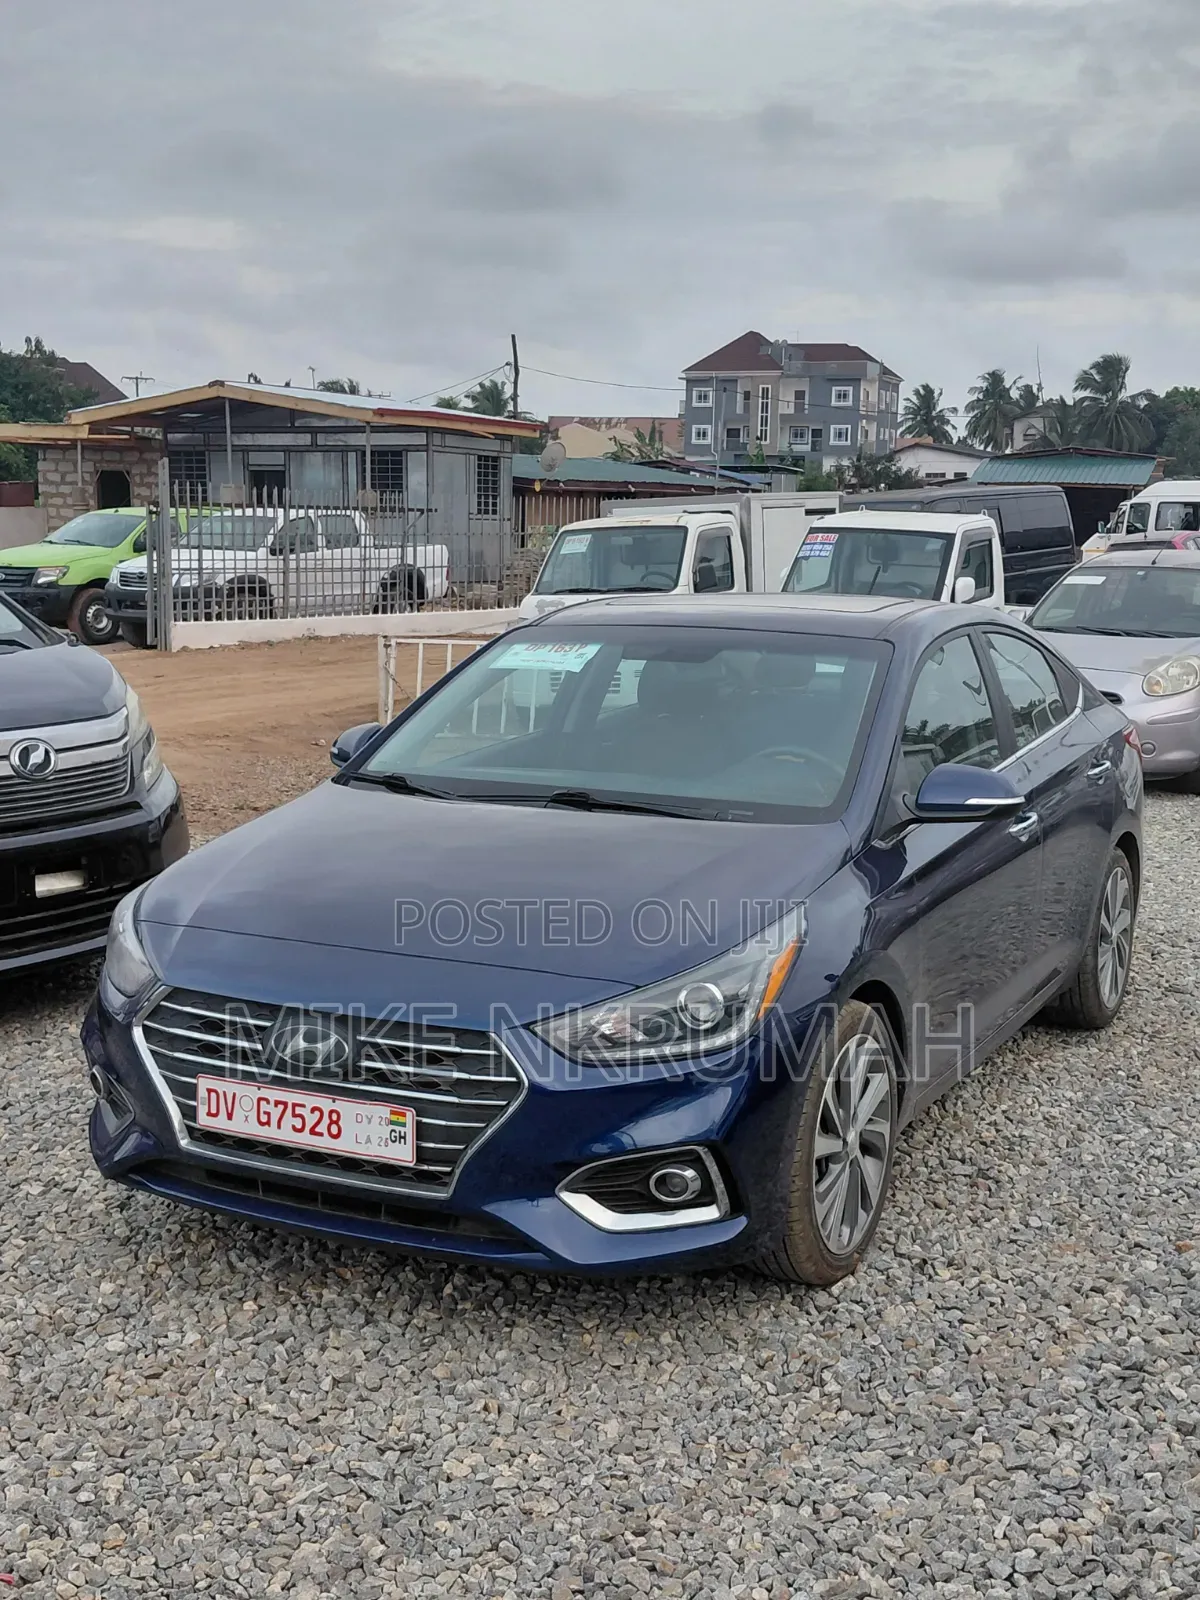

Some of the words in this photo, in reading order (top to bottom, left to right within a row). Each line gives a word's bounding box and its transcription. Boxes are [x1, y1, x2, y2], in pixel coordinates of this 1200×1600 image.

[805, 534, 819, 542] FOR
[820, 534, 837, 542] SALE
[205, 1087, 237, 1121] DV
[256, 1096, 343, 1140] G7528
[389, 1128, 407, 1146] GH
